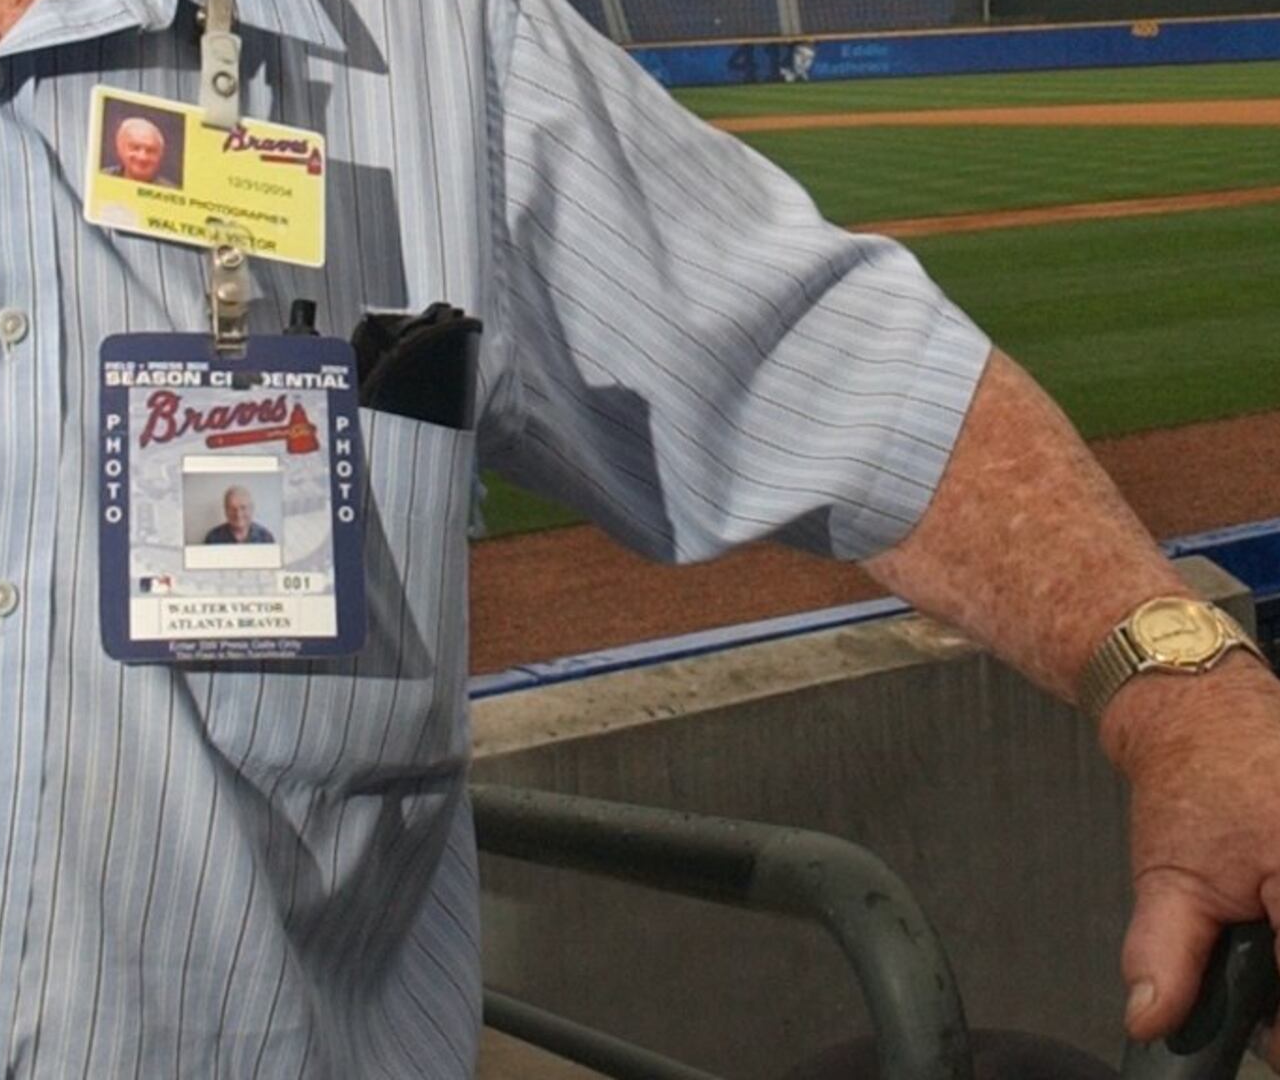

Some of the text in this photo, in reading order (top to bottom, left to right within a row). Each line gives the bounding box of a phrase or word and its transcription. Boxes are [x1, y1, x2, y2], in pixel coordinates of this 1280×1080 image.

[223, 122, 308, 154] Braves
[147, 217, 207, 238] WALTER
[106, 371, 202, 386] SEASON
[139, 391, 288, 449] Braves
[105, 414, 122, 523] PHOTO
[336, 415, 355, 523] PHOTO
[283, 576, 310, 590] 001
[168, 602, 284, 614] WALTER VICTOR
[168, 618, 291, 630] ATLANTA BRAVES
